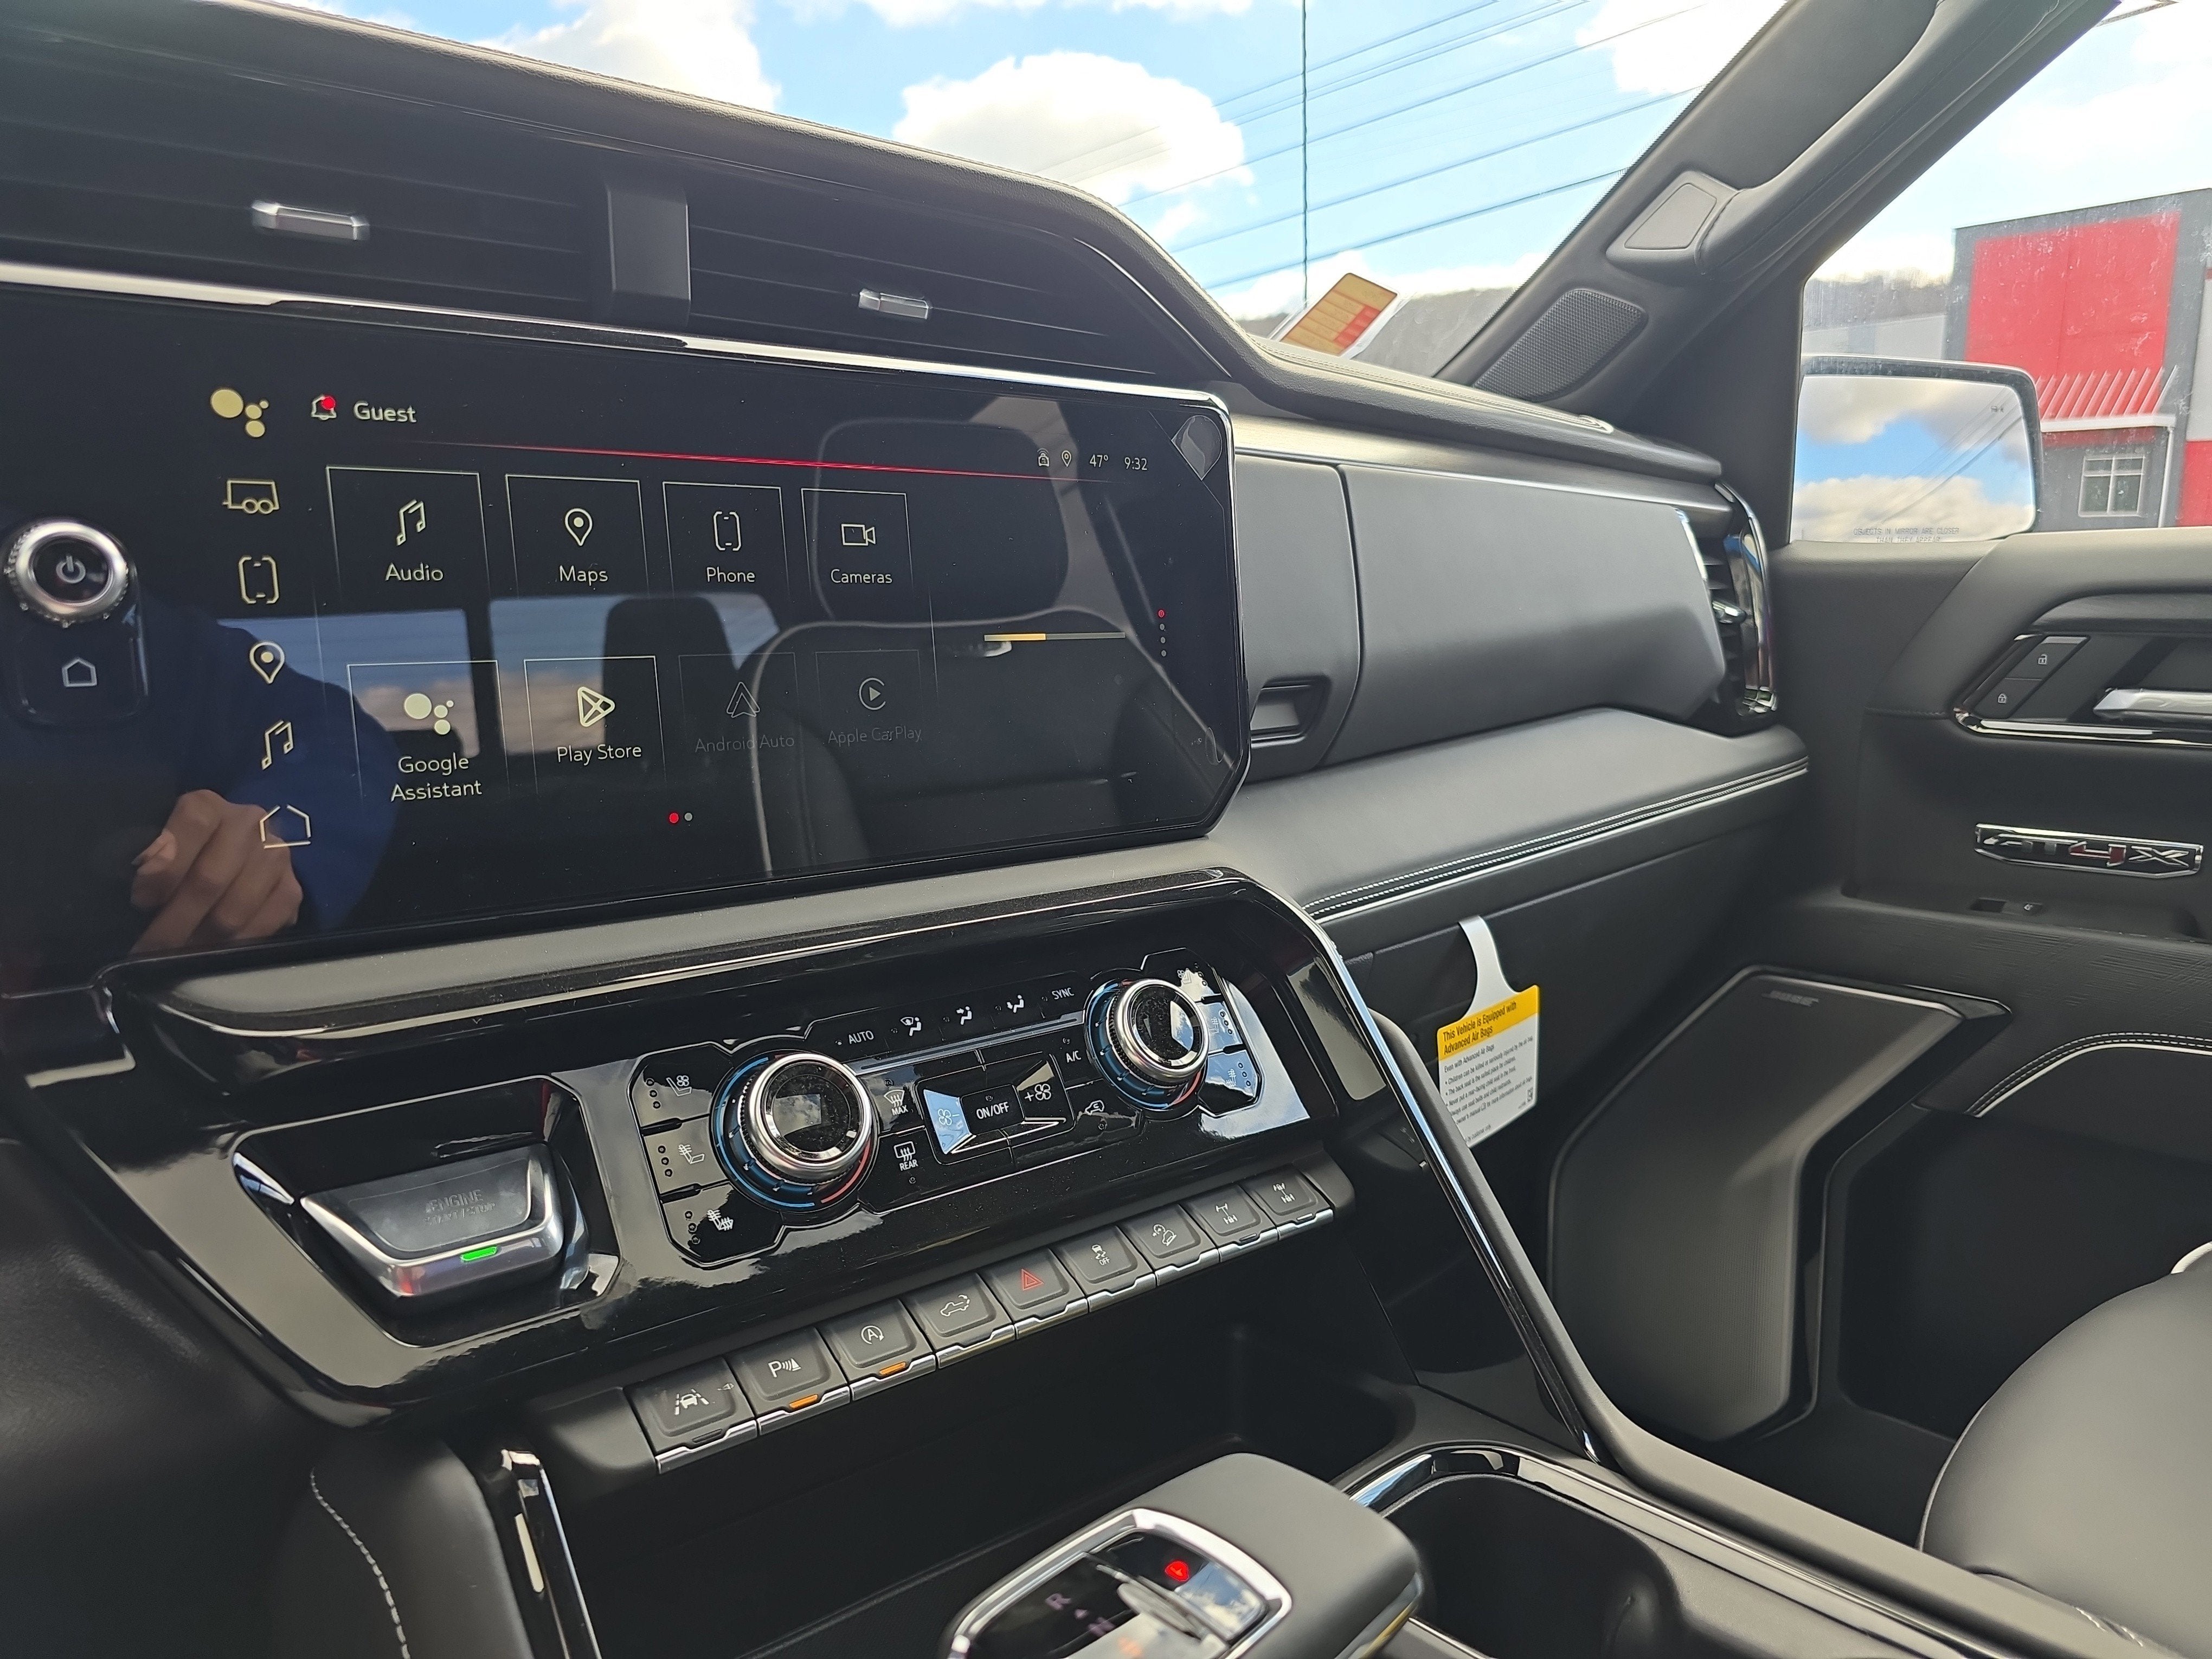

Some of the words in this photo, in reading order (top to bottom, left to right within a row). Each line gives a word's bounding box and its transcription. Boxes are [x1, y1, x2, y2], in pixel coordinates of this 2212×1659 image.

[353, 402, 417, 424] Guest
[1124, 457, 1148, 471] 9:32
[385, 563, 444, 582] Audio
[559, 565, 608, 585] Maps
[706, 567, 755, 583] Phone
[831, 569, 893, 584] Cameras
[695, 735, 756, 753] Android
[760, 735, 795, 749] Auto
[828, 729, 867, 745] Apple
[871, 725, 922, 743] CarPlay
[398, 752, 470, 774] Google
[557, 745, 593, 765] Play
[597, 744, 642, 761] Store
[390, 780, 483, 802] Assistant
[1051, 987, 1075, 1000] SYNC
[1443, 1028, 1456, 1042] This
[1456, 1019, 1476, 1036] Vehicle
[1476, 1017, 1482, 1027] is
[1482, 1005, 1505, 1024] Equipped
[1506, 1001, 1517, 1013] with
[848, 1030, 875, 1045] AUTO
[1443, 1036, 1470, 1056] Advanced
[1471, 1030, 1479, 1041] Air
[1480, 1025, 1493, 1038] Bags
[1065, 1050, 1082, 1063] A/C
[1444, 1064, 1454, 1073] Even
[1454, 1059, 1463, 1068] with
[1463, 1050, 1480, 1064] Advanced
[891, 1104, 909, 1116] MAX
[976, 1101, 1010, 1119] ON/OFF
[898, 1159, 918, 1171] REAR
[426, 1189, 484, 1214] ENGINE
[1099, 1257, 1110, 1266] OFF
